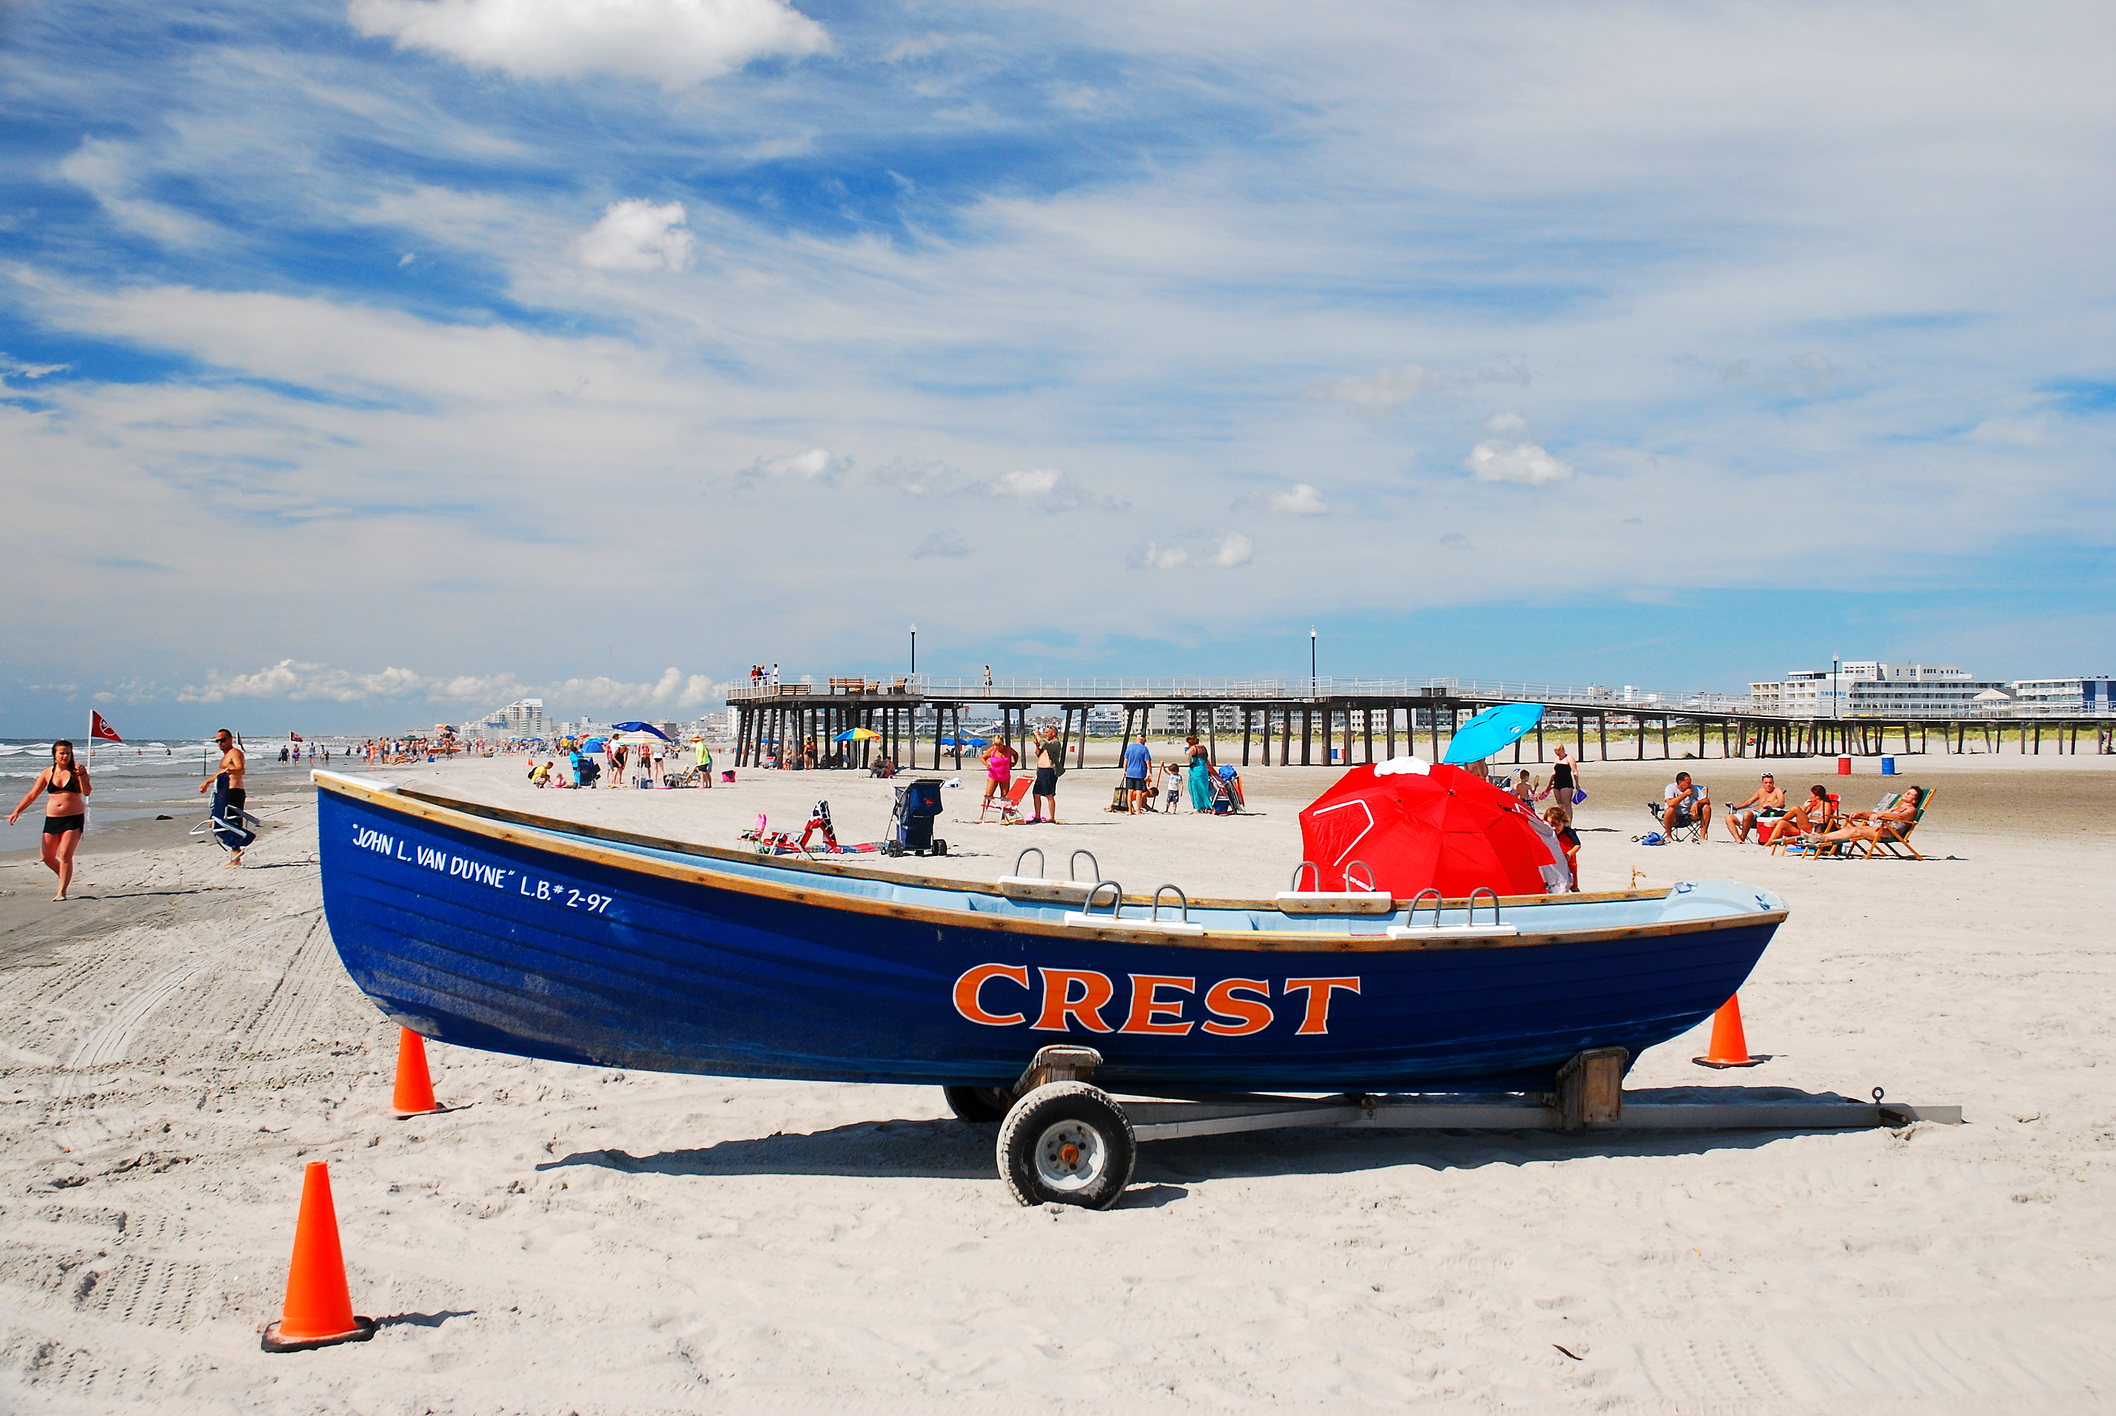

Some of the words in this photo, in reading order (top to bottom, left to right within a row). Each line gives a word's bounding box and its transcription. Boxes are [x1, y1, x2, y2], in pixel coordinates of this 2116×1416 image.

[397, 840, 412, 862] L.
[417, 845, 447, 872] VAN
[953, 962, 1361, 1037] CREST
